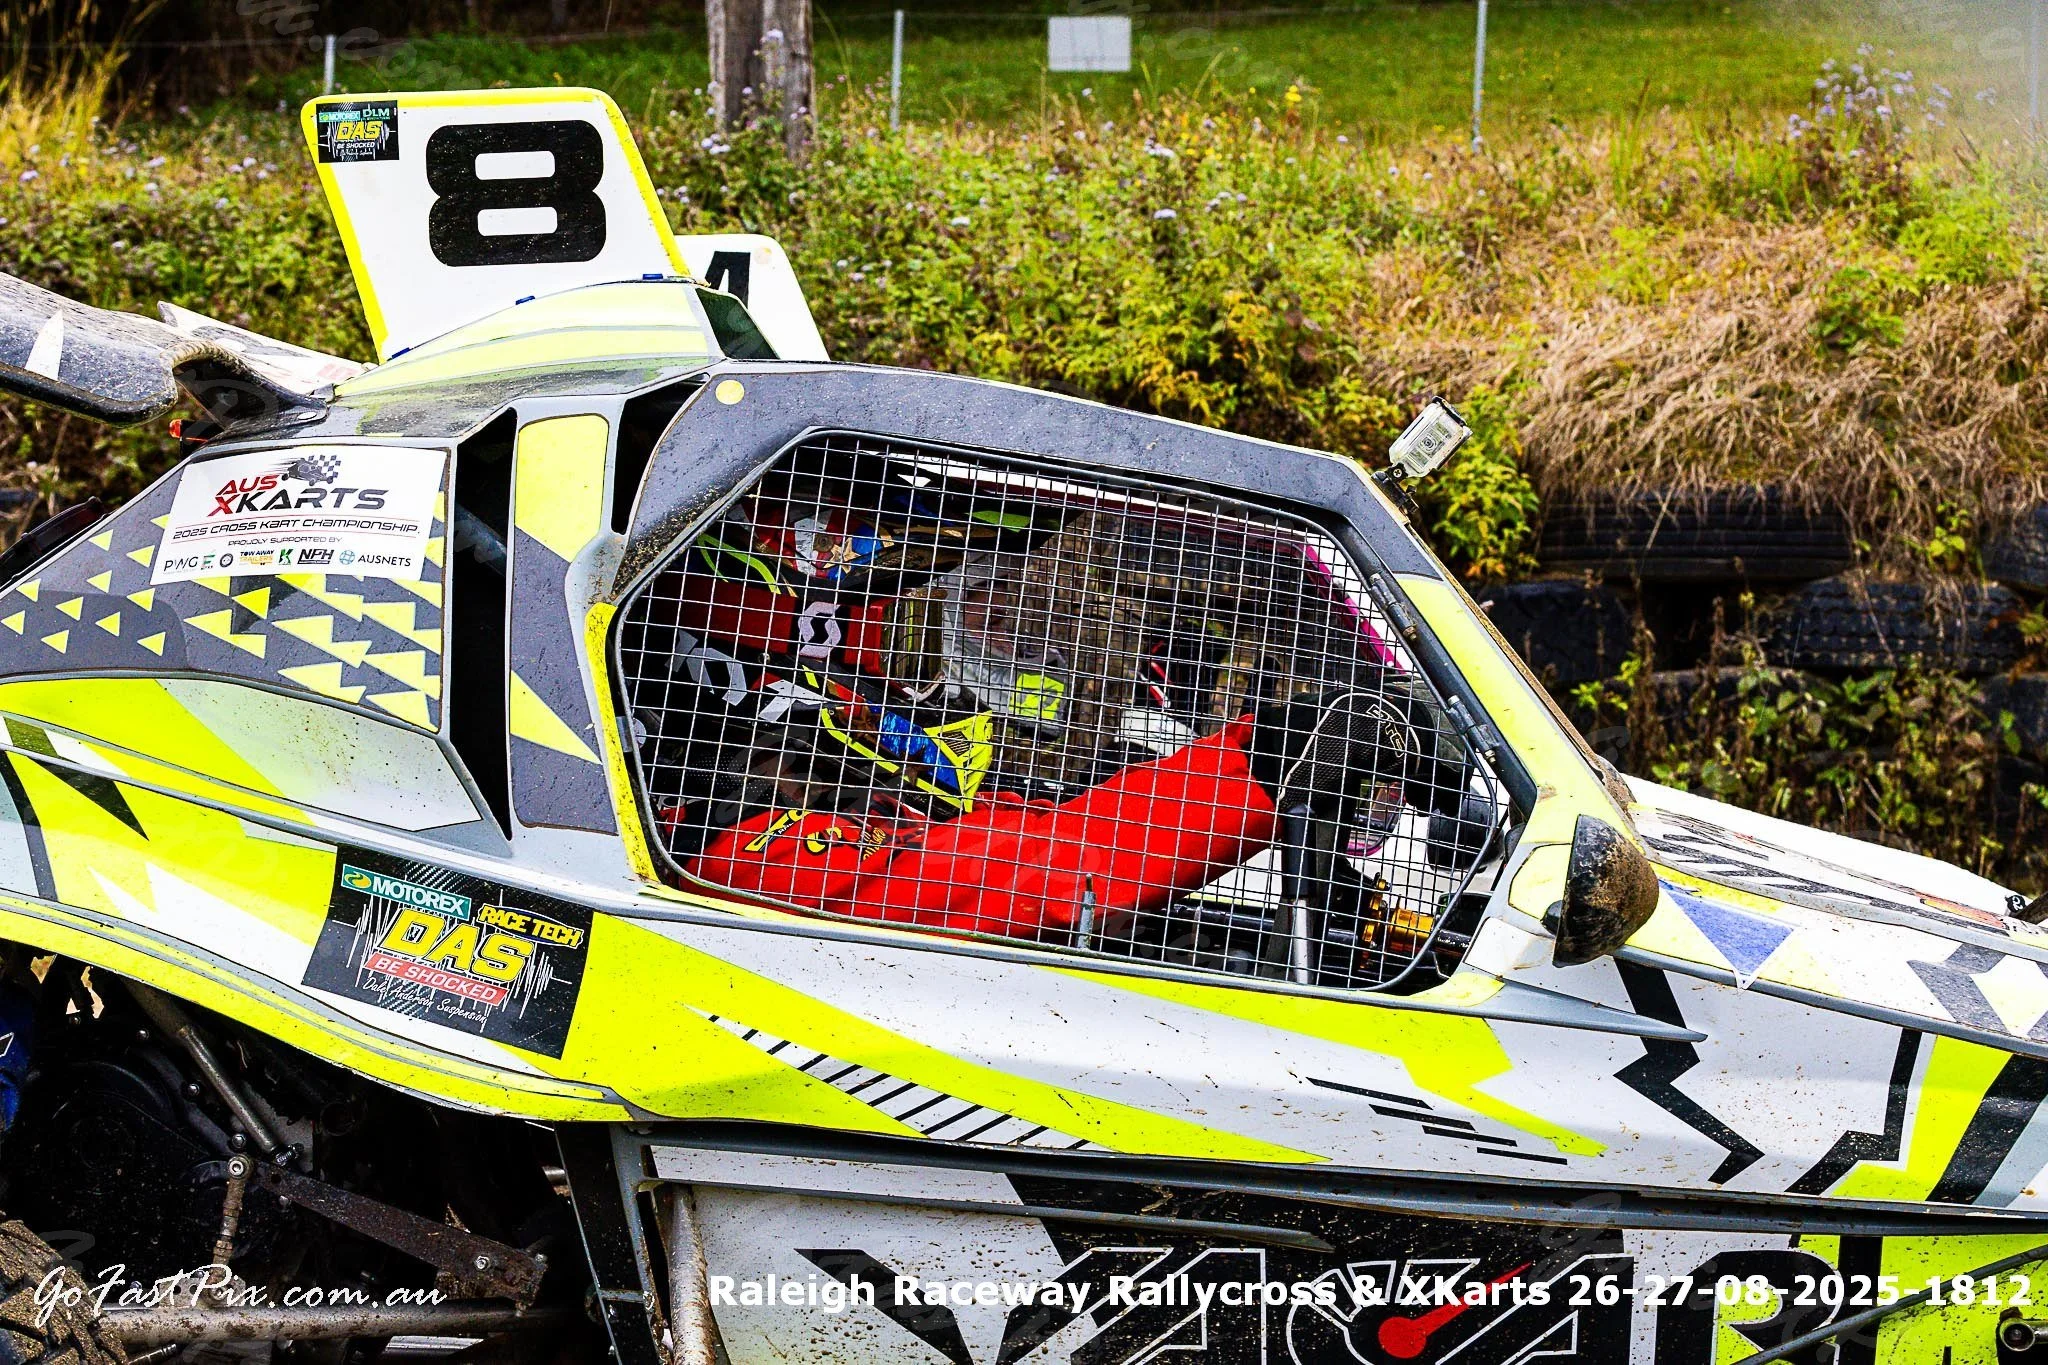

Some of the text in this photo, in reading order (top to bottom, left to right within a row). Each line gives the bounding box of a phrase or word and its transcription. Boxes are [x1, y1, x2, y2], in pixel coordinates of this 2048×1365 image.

[336, 120, 384, 140] DAS
[346, 141, 376, 149] SHOCKED
[425, 118, 607, 268] 8
[215, 473, 281, 496] AUS
[206, 486, 390, 518] XKARTS
[172, 526, 209, 541] 2025
[210, 520, 258, 534] CROSS
[259, 518, 301, 531] KART
[227, 535, 344, 547] PROUDLY SUPPORTED BY
[357, 554, 412, 567] AUSNETS
[371, 876, 466, 917] MOTOREX
[478, 904, 584, 948] RACE TECH
[378, 907, 536, 983] DAS
[373, 956, 499, 1001] BE SHOCKED
[362, 975, 488, 1024] Dale Anderson Suspension
